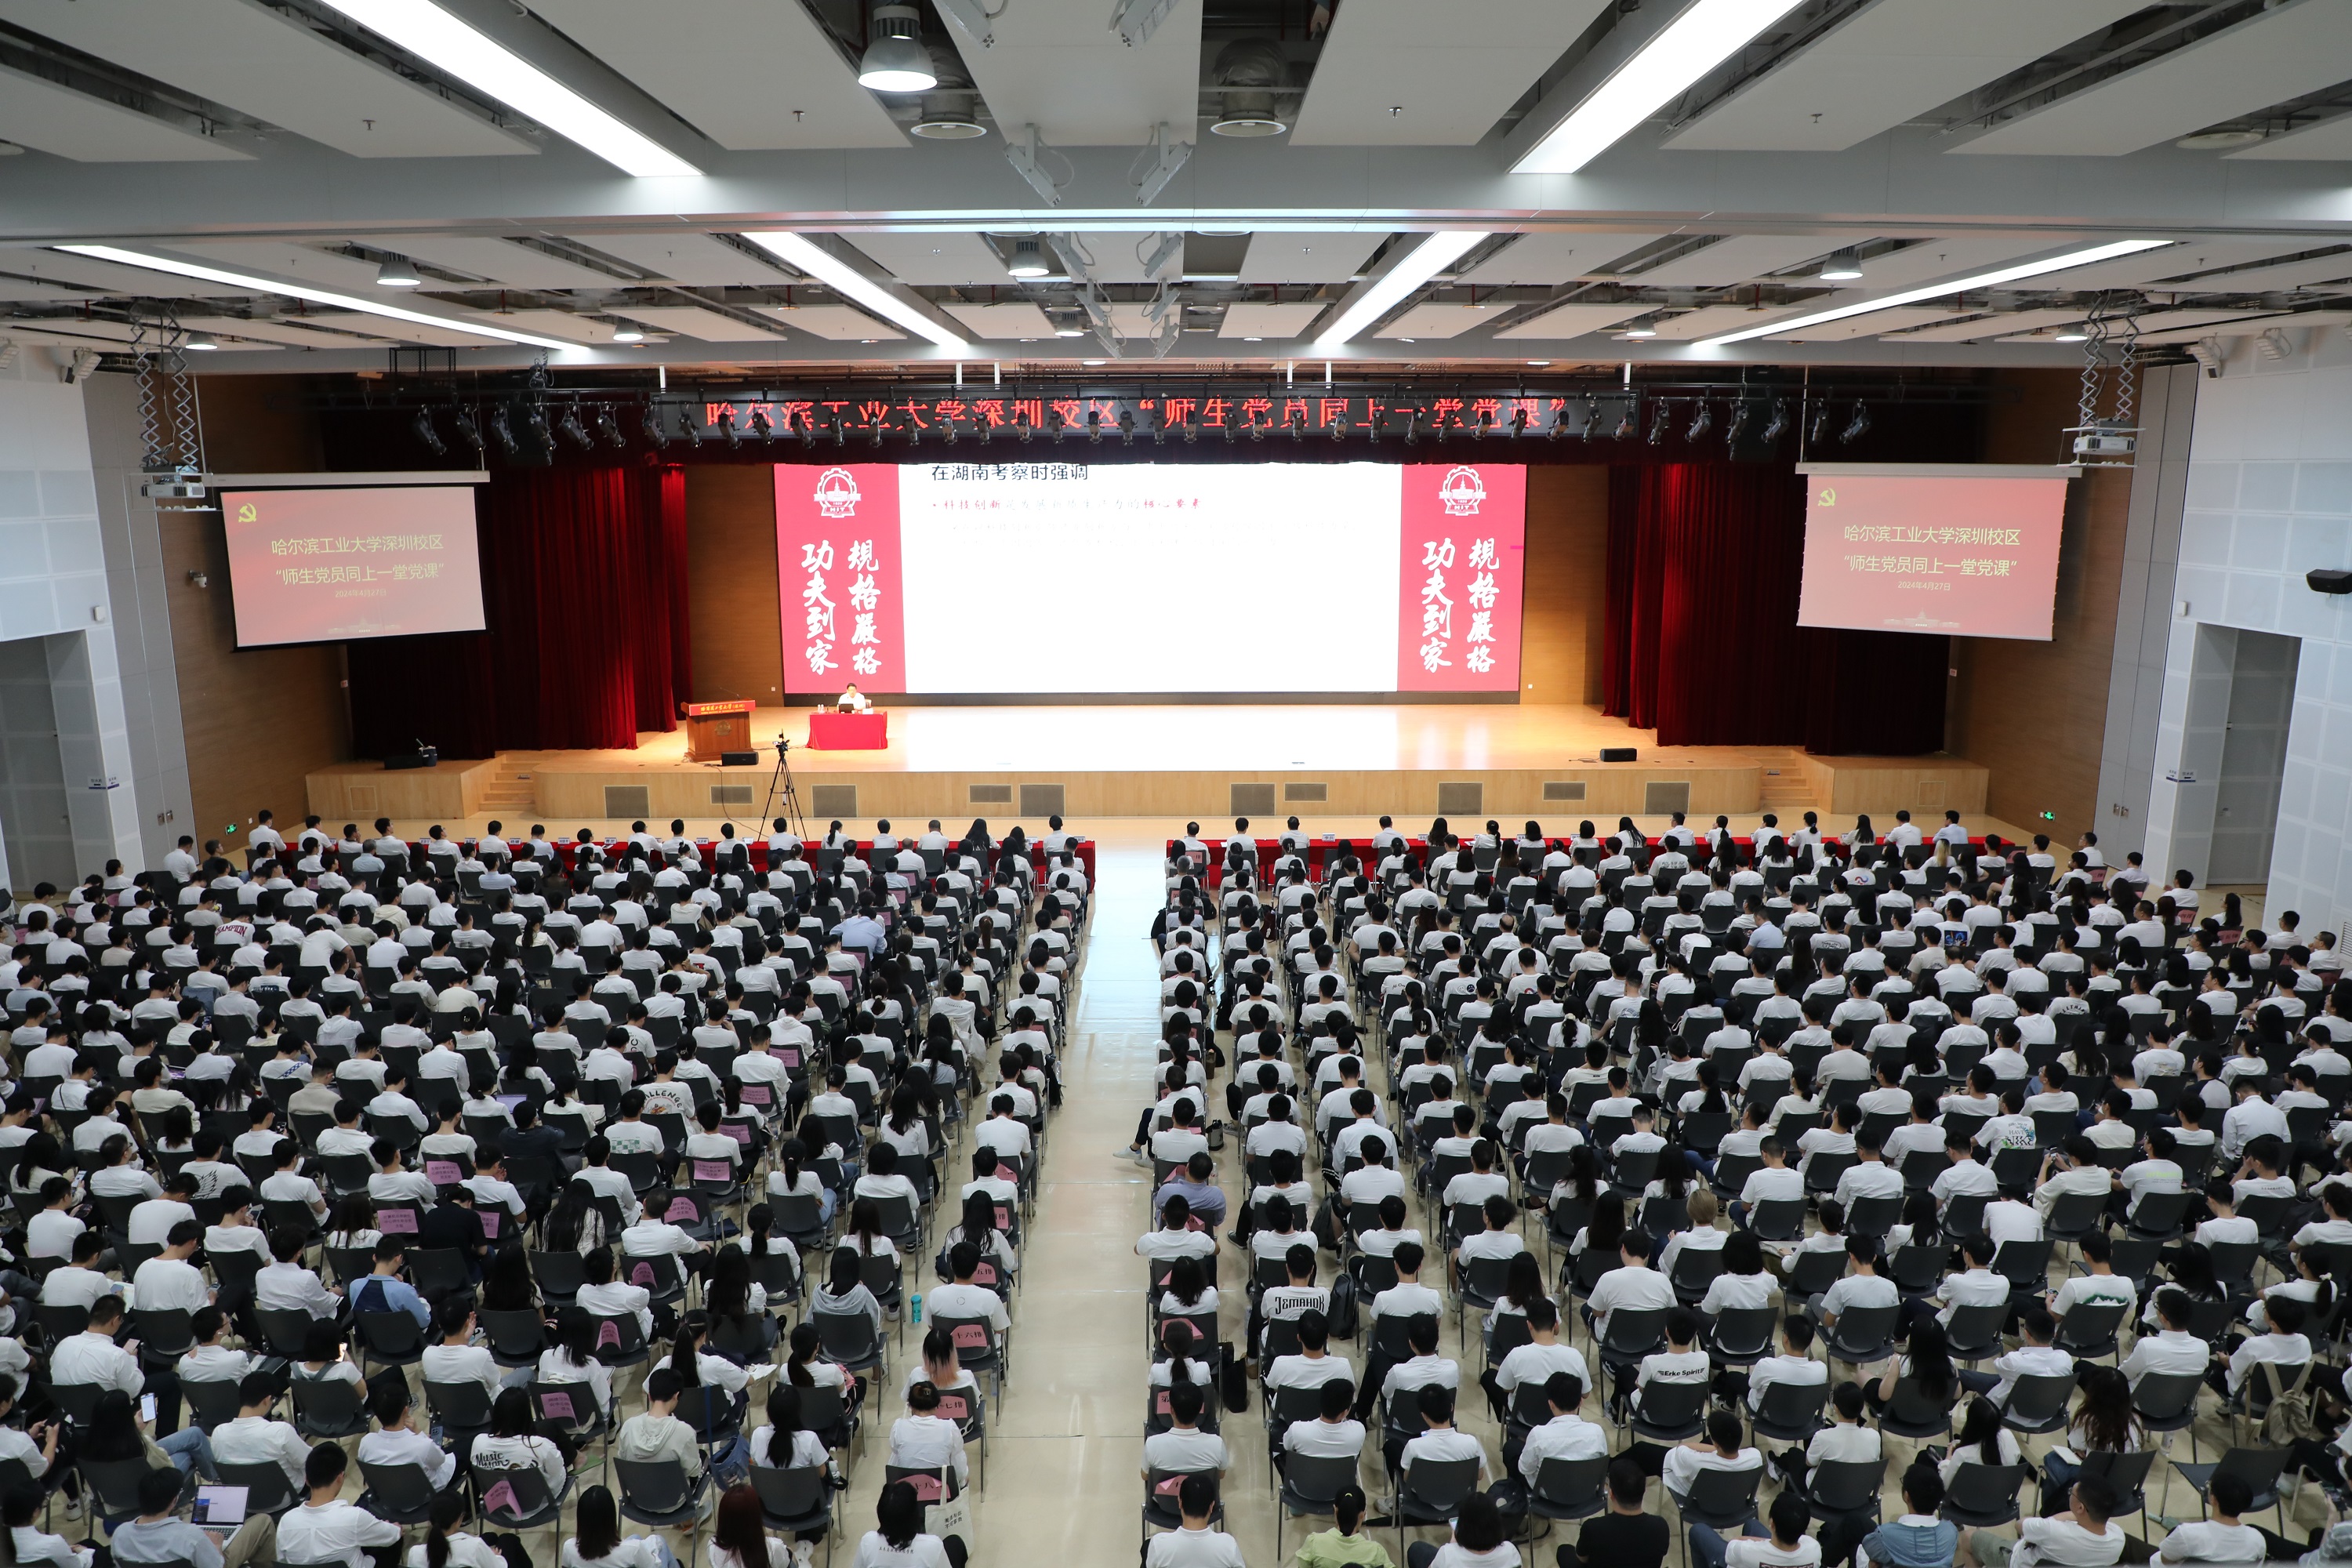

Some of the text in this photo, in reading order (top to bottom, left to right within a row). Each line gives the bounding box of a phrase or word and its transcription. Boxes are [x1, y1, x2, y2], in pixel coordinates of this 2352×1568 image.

[931, 464, 1088, 481] 在湖南考察时强调
[1844, 524, 2022, 546] 哈尔滨工业大学深圳校区
[271, 534, 444, 556] 哈尔滨工业大学深圳校区
[335, 589, 387, 597] 2024年4月27日
[1897, 581, 1951, 591] 2024年4月27日
[800, 539, 839, 676] 功夫到家
[1419, 537, 1455, 673] 功夫到家
[644, 1090, 683, 1109] ALLENGE
[475, 1451, 505, 1466] Music
